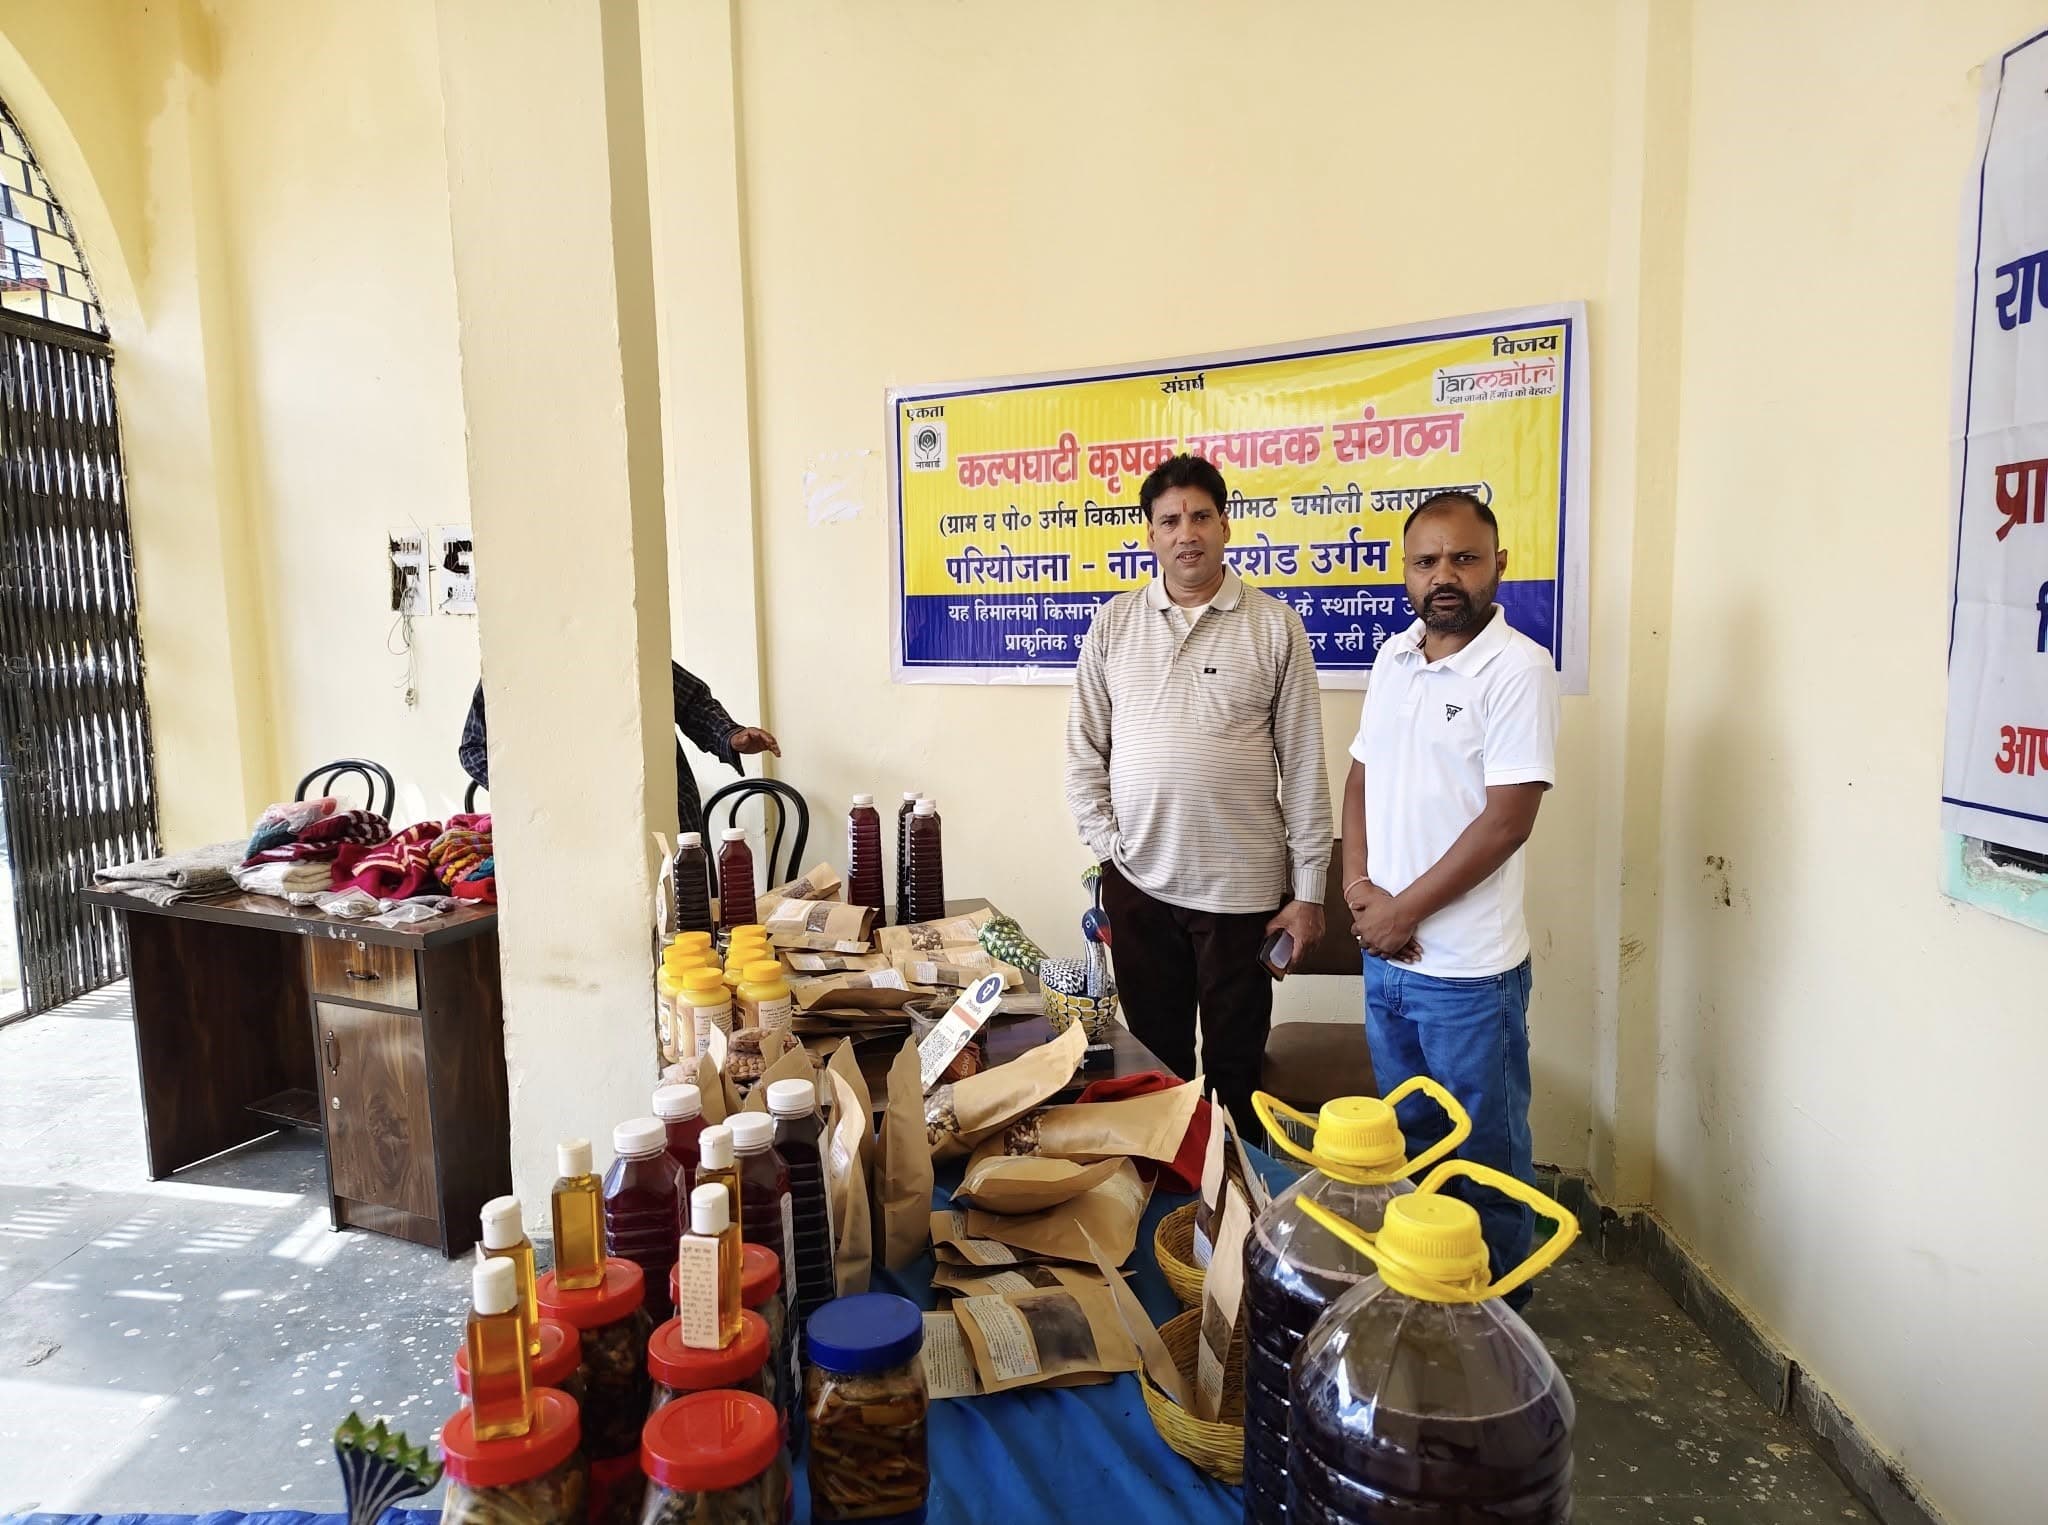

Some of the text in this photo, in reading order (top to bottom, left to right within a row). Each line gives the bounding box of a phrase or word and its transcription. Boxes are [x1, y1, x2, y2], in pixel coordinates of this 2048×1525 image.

[1493, 335, 1558, 356] विजय
[1160, 372, 1205, 393] संघर्ष
[1436, 357, 1555, 402] janmaitri
[906, 406, 944, 421] एकता
[958, 432, 1080, 487] कल्पघाटी
[1088, 439, 1177, 493] कृषक
[1333, 406, 1464, 462] संगठन
[940, 514, 977, 537] (ग्राम
[984, 514, 996, 531] व
[1039, 501, 1078, 530] उर्गम
[1291, 483, 1363, 516] चमोली
[947, 545, 1070, 585] परियोजना
[1108, 541, 1157, 579] नॉन
[1310, 527, 1391, 574] उर्गम
[948, 605, 970, 621] यह
[974, 598, 1039, 622] हिमालयी
[1295, 592, 1314, 617] के
[1321, 590, 1395, 616] स्थानिय
[1005, 628, 1068, 657] प्राकृतिक
[1334, 624, 1365, 651] रही
